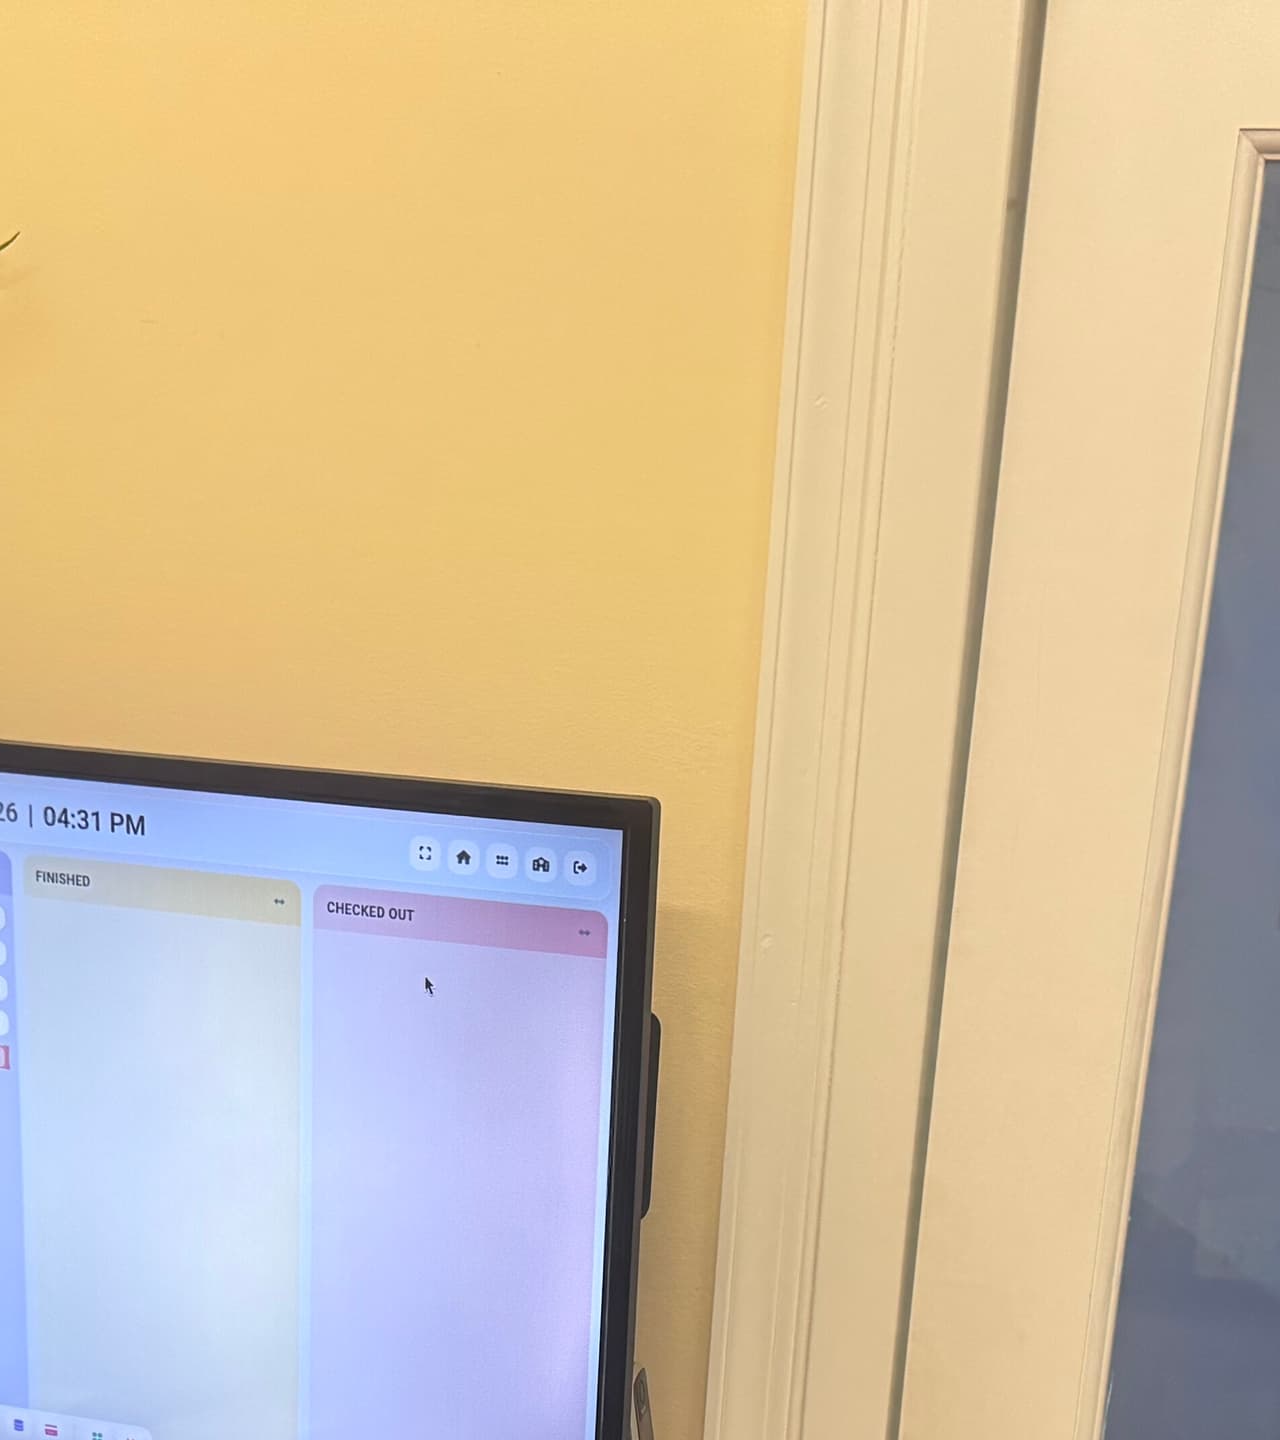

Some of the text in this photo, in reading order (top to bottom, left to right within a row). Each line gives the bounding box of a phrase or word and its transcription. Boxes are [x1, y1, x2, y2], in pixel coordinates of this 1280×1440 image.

[43, 806, 101, 832] 04:31
[109, 812, 145, 836] PM
[35, 870, 90, 887] FINISHED
[327, 901, 415, 921] CHECKED OUT
